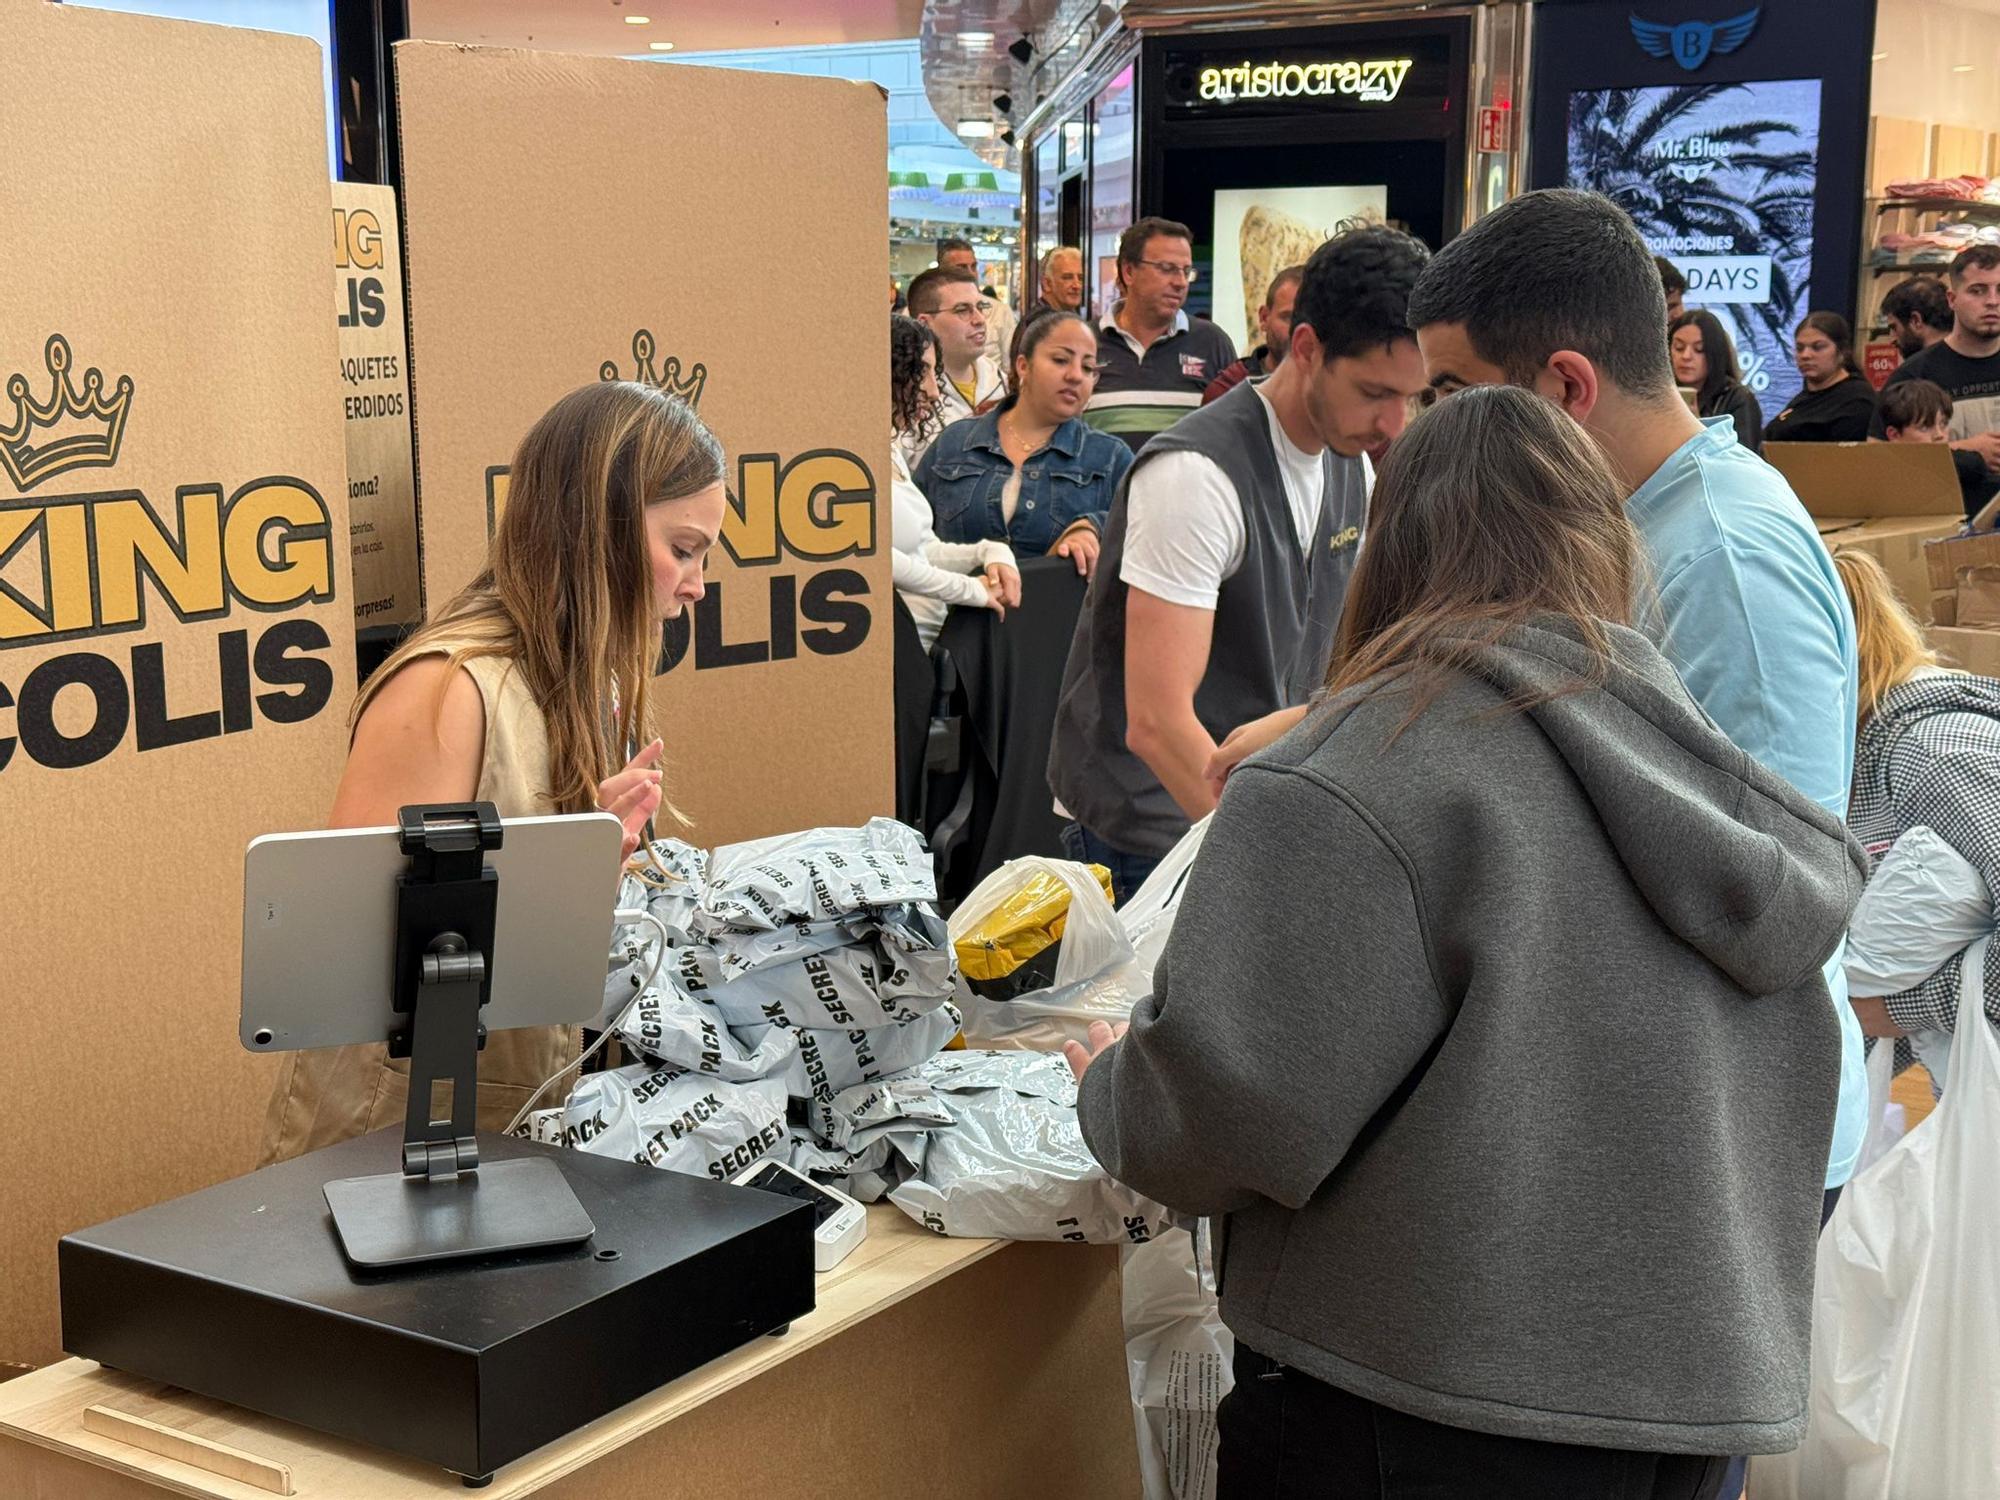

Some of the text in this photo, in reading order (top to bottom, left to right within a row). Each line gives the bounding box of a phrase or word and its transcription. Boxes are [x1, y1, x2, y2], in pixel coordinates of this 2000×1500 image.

[1200, 59, 1412, 101] aristocrazy
[1654, 136, 1731, 159] Mr. Blue
[1687, 267, 1760, 291] DAYS
[343, 393, 403, 420] ERDIDOS
[0, 619, 333, 773] OLIS
[700, 1018, 722, 1074] PACK
[848, 1028, 876, 1068] PAC
[670, 1092, 724, 1141] PACK
[708, 1117, 785, 1182] SECRET
